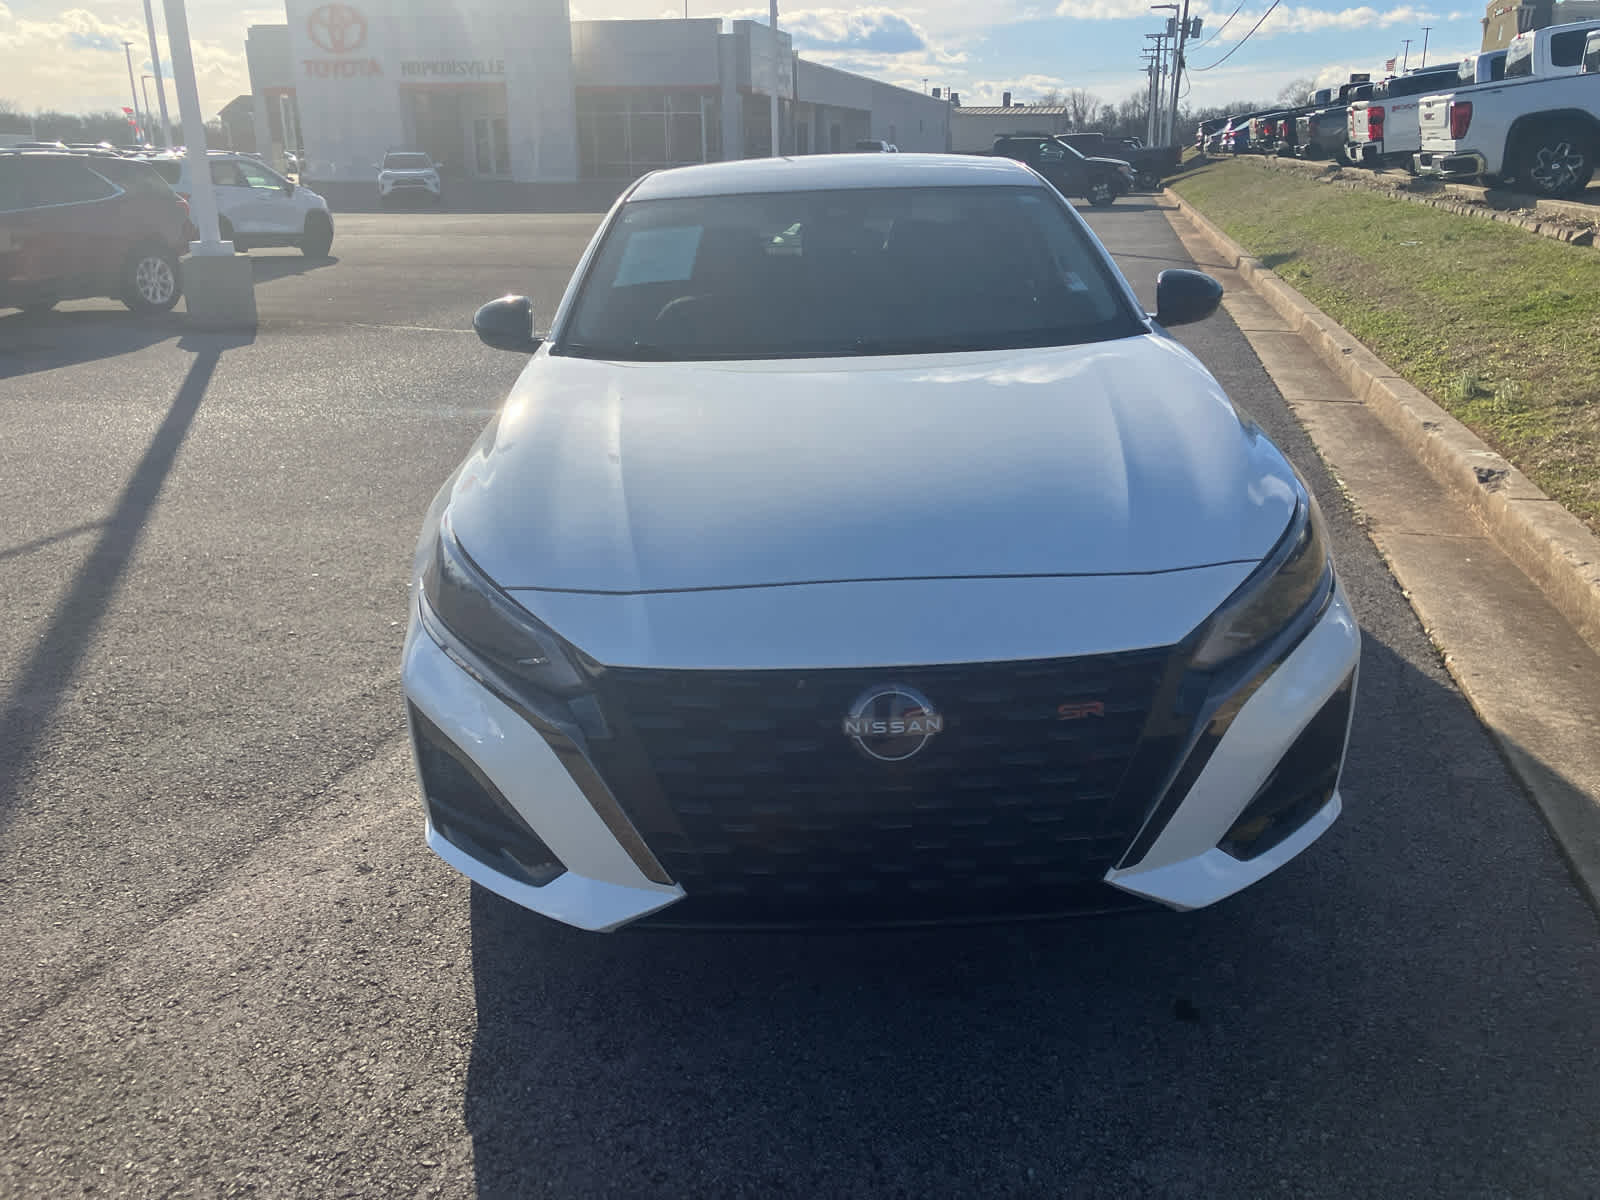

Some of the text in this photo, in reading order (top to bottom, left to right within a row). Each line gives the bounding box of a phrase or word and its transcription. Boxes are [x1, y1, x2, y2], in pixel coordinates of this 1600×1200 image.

[304, 59, 381, 77] TOYOTA
[1057, 701, 1104, 720] SR
[845, 718, 941, 734] NISSAN
